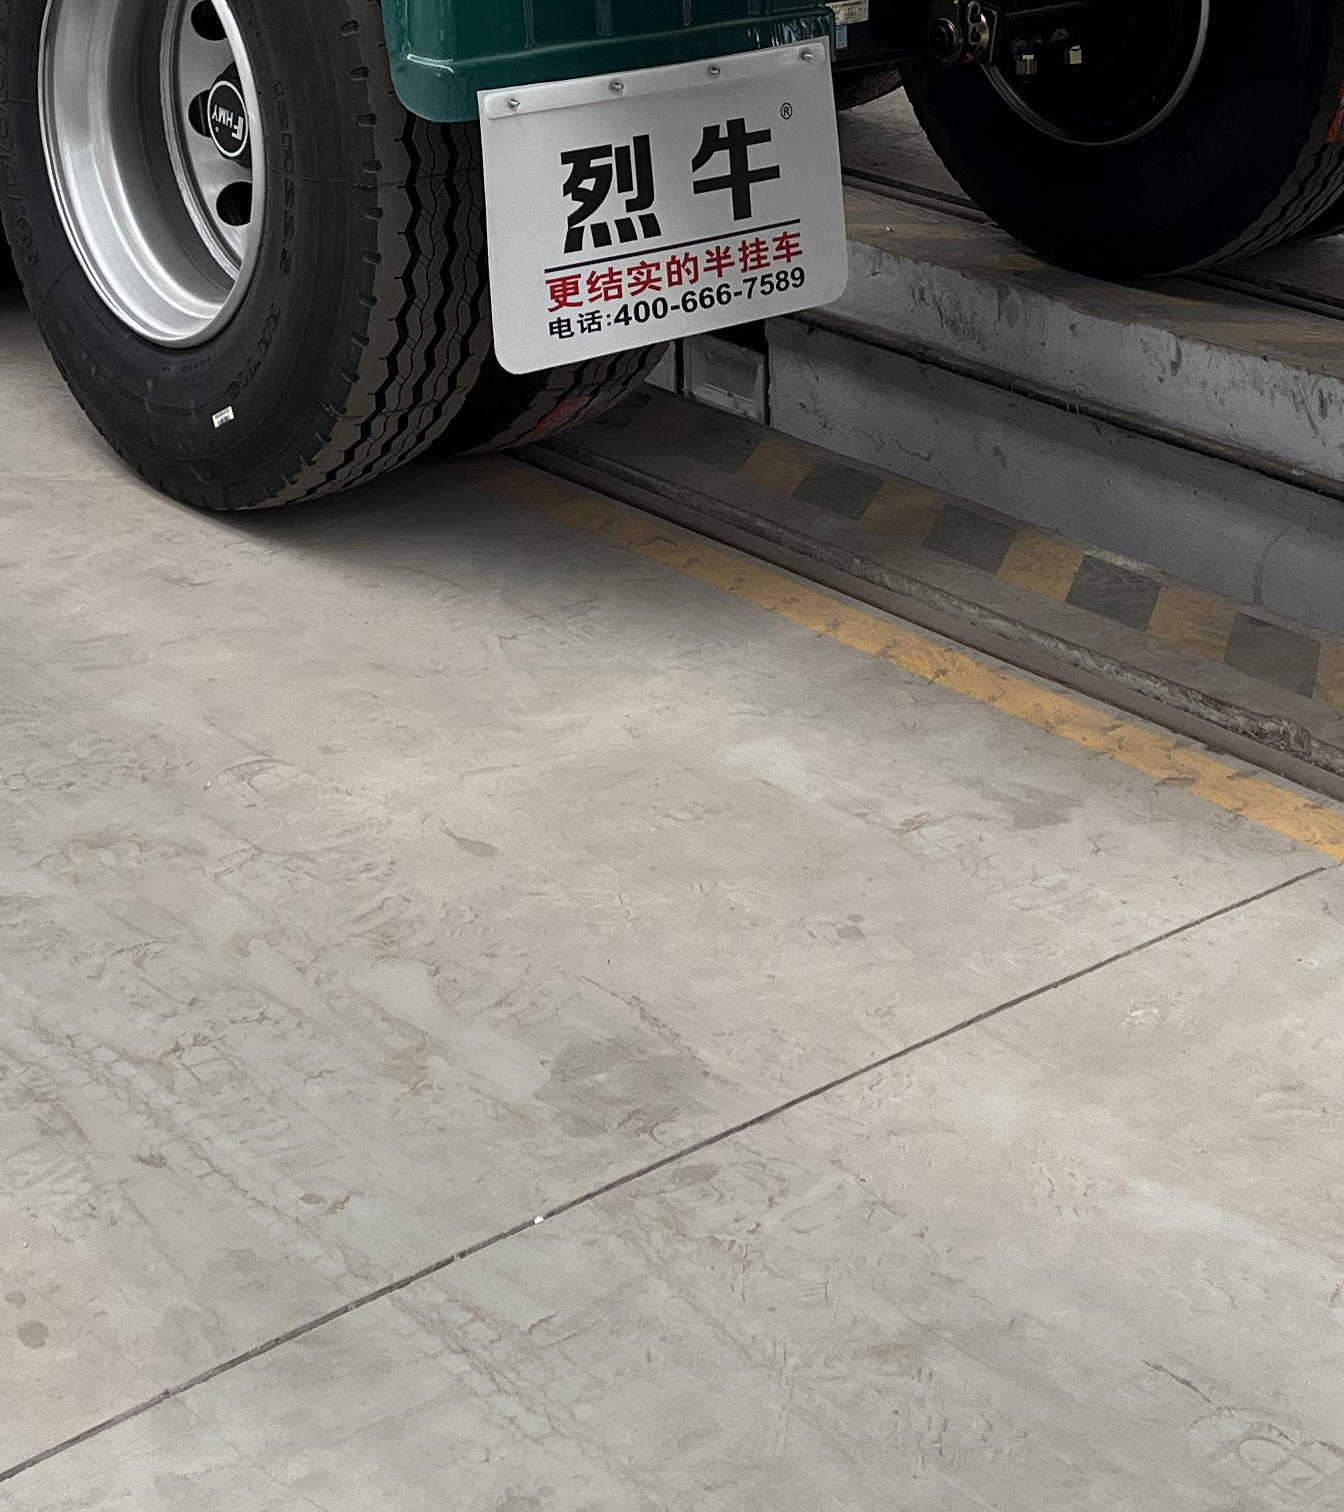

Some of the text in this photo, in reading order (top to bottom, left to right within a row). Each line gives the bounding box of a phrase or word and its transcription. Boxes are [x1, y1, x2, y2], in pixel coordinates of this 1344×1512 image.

[559, 117, 781, 255] 烈牛
[545, 230, 804, 313] 更结实的半挂车
